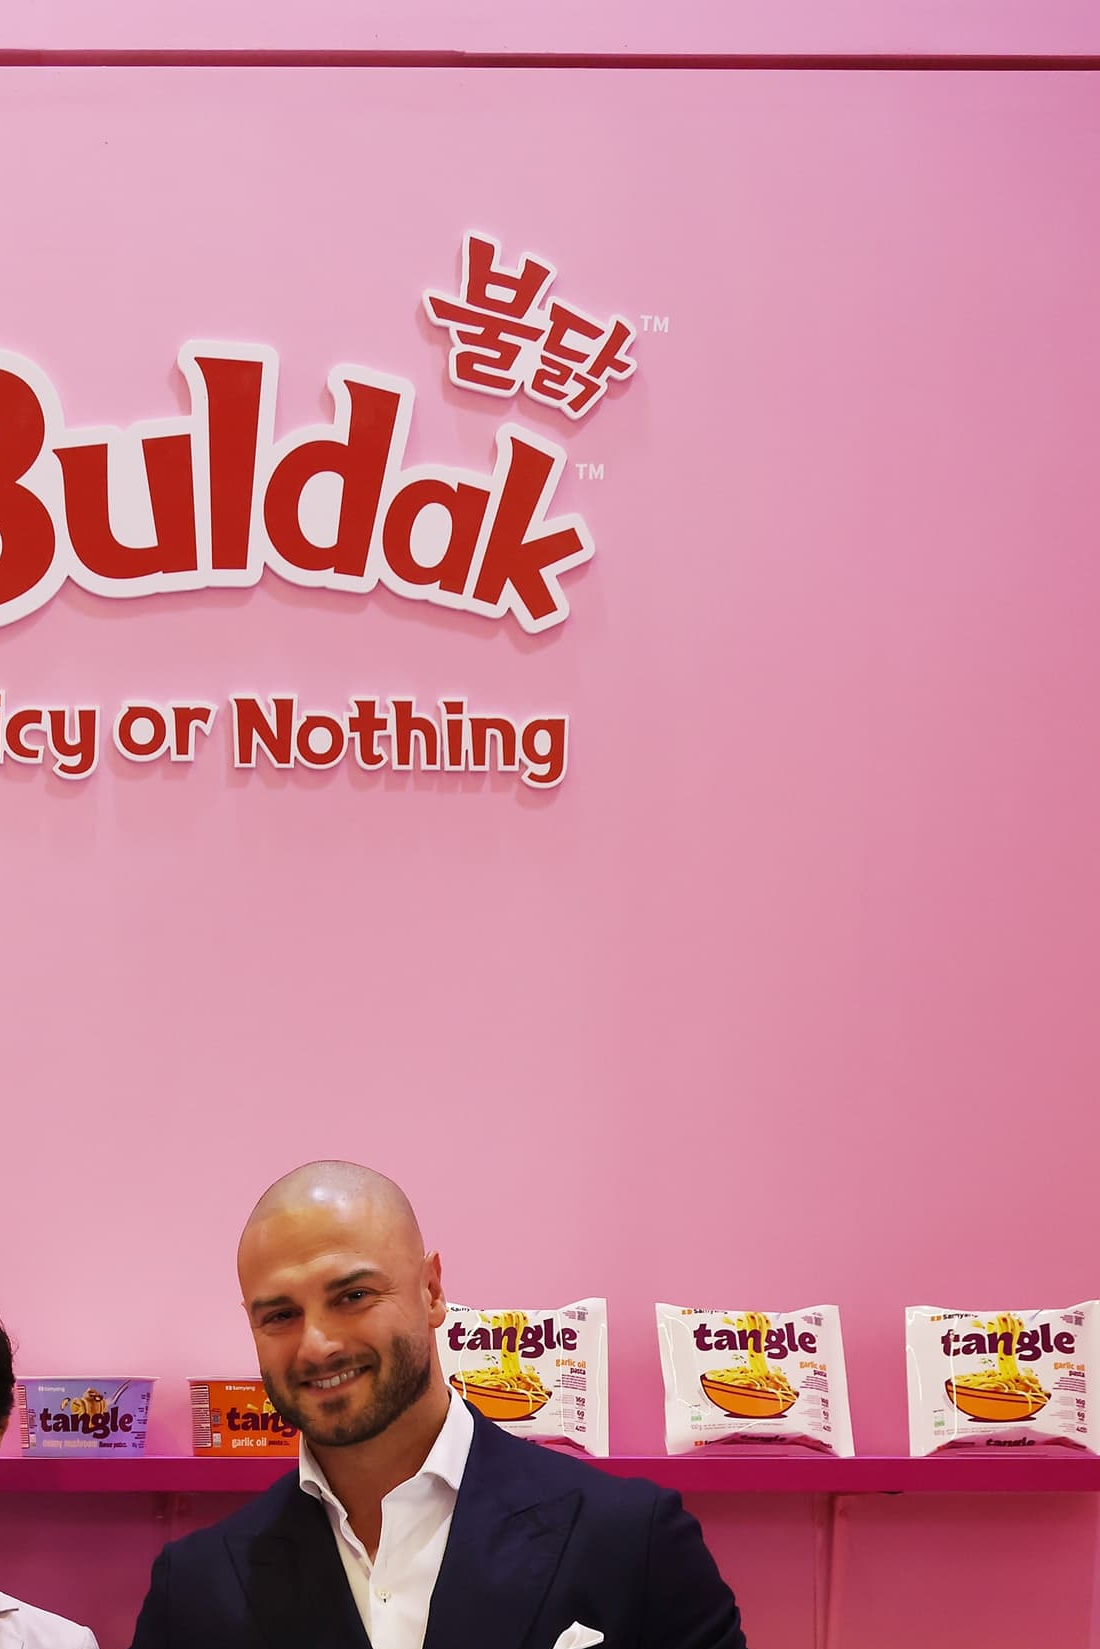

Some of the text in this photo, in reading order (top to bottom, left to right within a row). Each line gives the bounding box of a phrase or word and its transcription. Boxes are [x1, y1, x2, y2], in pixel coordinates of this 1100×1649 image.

[424, 232, 637, 416] 불닭
[114, 701, 215, 764] or
[232, 694, 570, 788] Nothing
[448, 1318, 578, 1359] tangle
[693, 1322, 818, 1360] tangle
[941, 1323, 1076, 1361] tangle
[555, 1358, 587, 1369] garlic oil
[40, 1407, 133, 1439] tangle
[232, 1437, 254, 1448] garlic
[256, 1438, 267, 1447] oil
